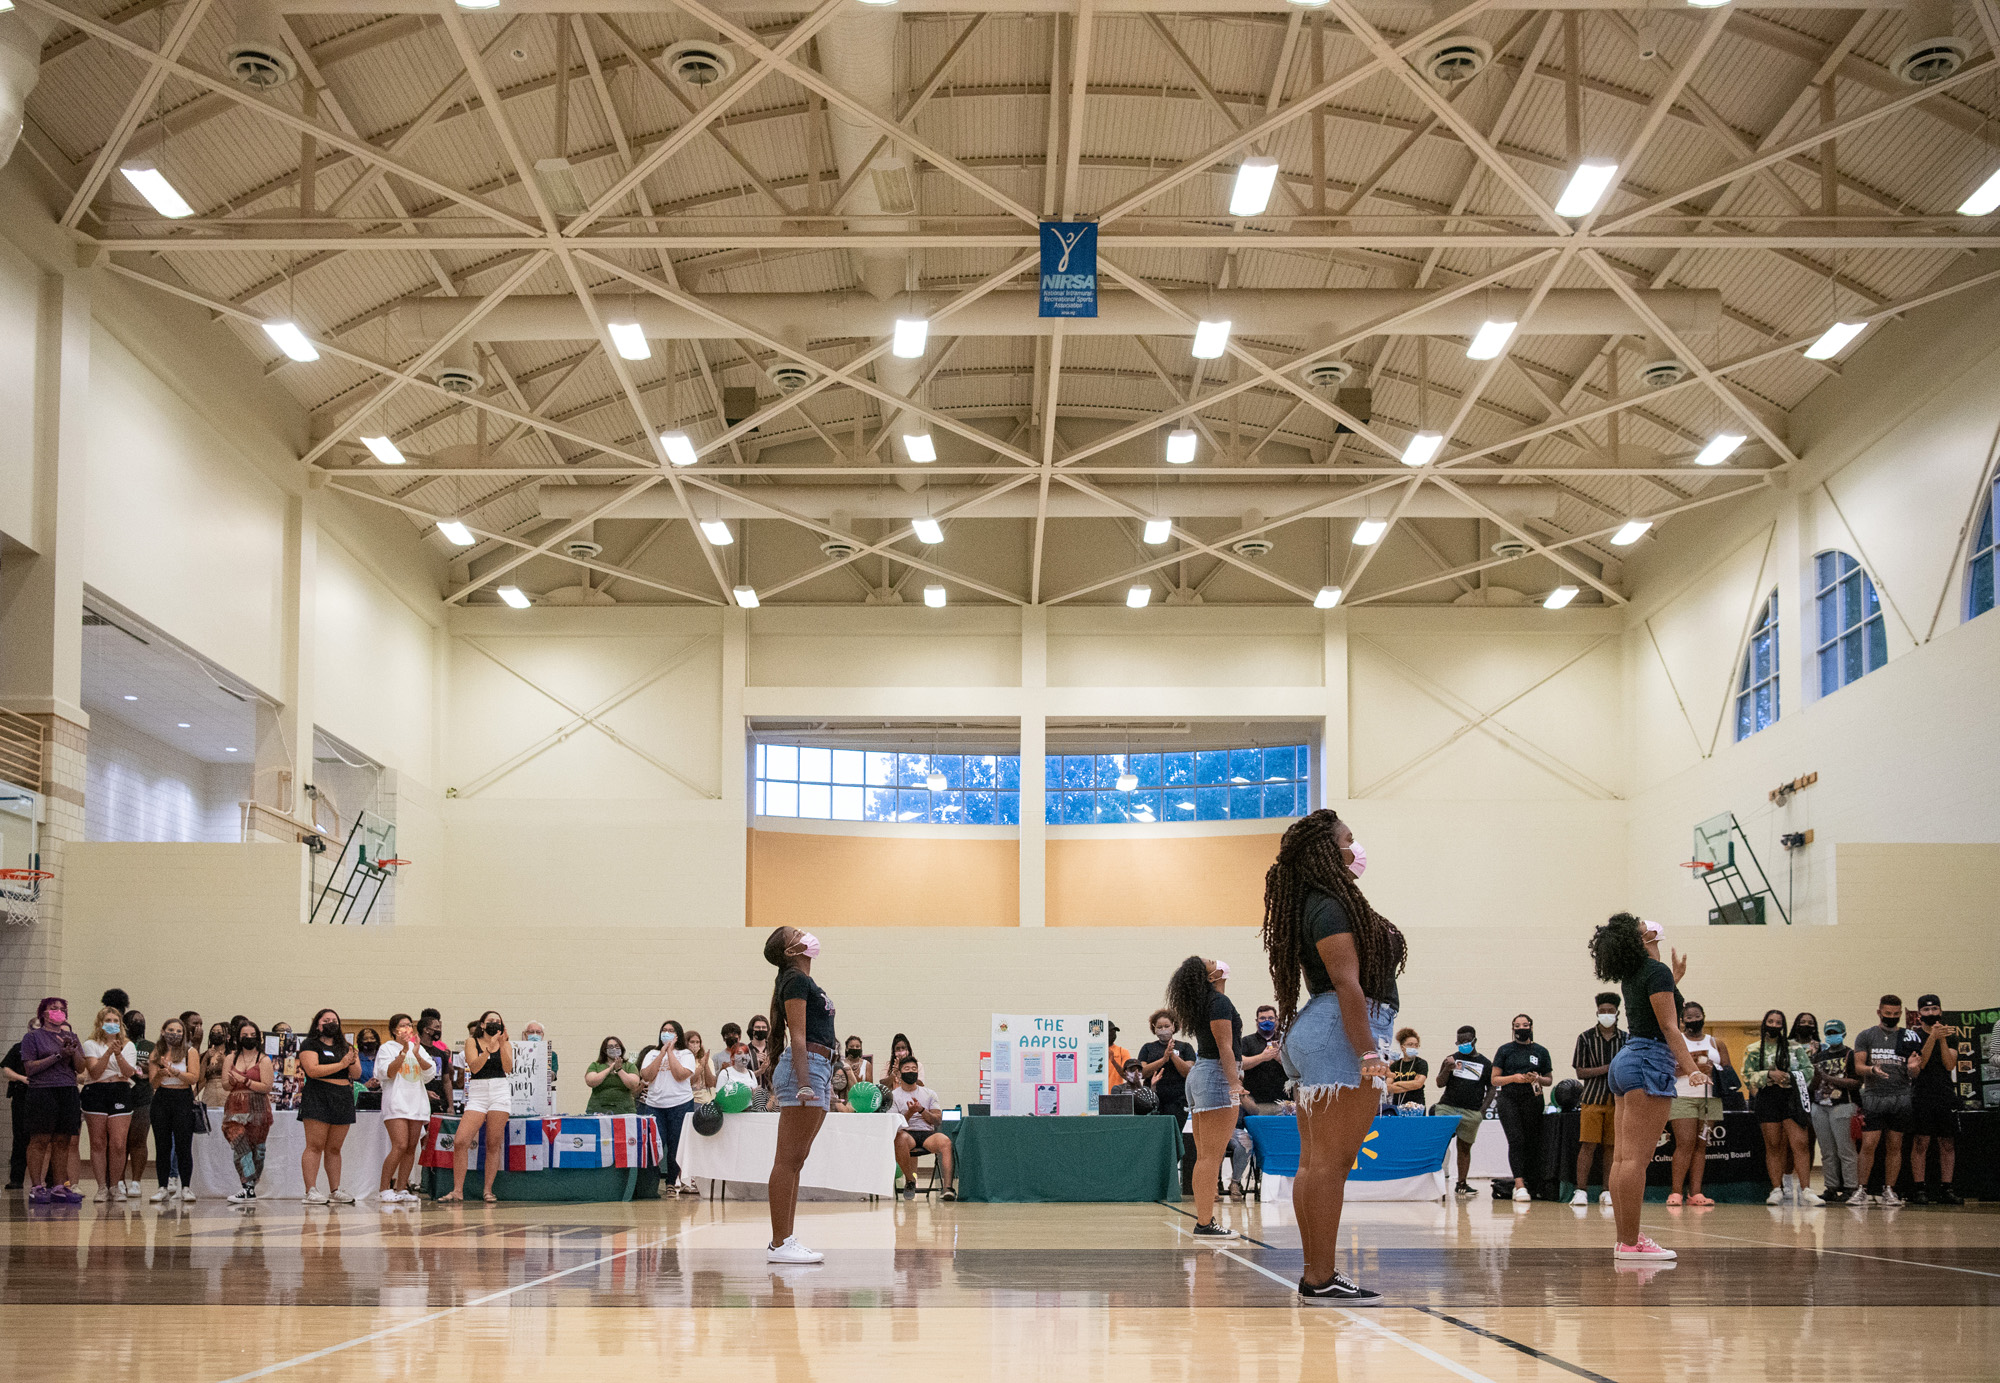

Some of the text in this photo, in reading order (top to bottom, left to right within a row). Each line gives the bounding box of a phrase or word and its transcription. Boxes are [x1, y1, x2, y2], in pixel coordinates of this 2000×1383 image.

[1042, 274, 1095, 289] NIRSA
[1034, 1018, 1064, 1032] THE
[1961, 1010, 2000, 1026] UNIO
[1019, 1035, 1078, 1049] AAPISU
[1871, 1054, 1906, 1062] RESPECT
